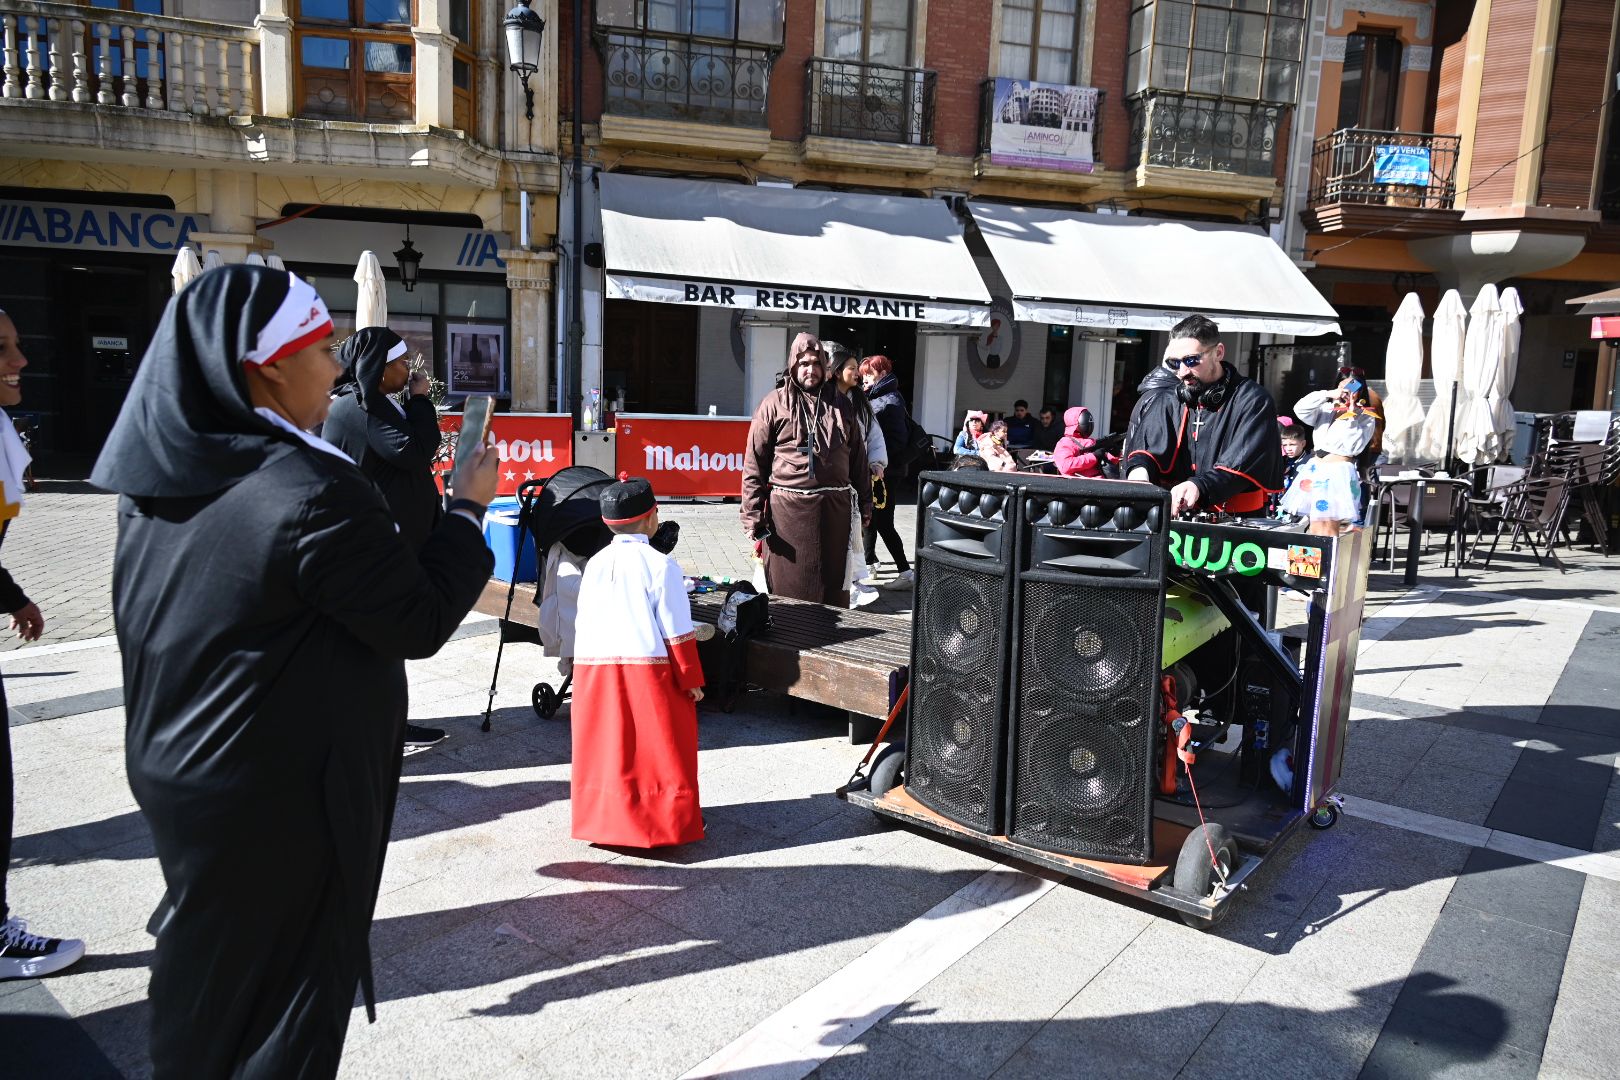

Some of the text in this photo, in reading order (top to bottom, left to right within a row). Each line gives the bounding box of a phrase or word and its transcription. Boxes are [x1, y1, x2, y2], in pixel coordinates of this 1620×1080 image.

[1027, 132, 1060, 143] AMINCO
[1400, 147, 1425, 155] VENTA
[684, 283, 926, 319] BAR RESTAURANTE
[453, 370, 469, 380] 2%
[643, 444, 746, 471] Mahou
